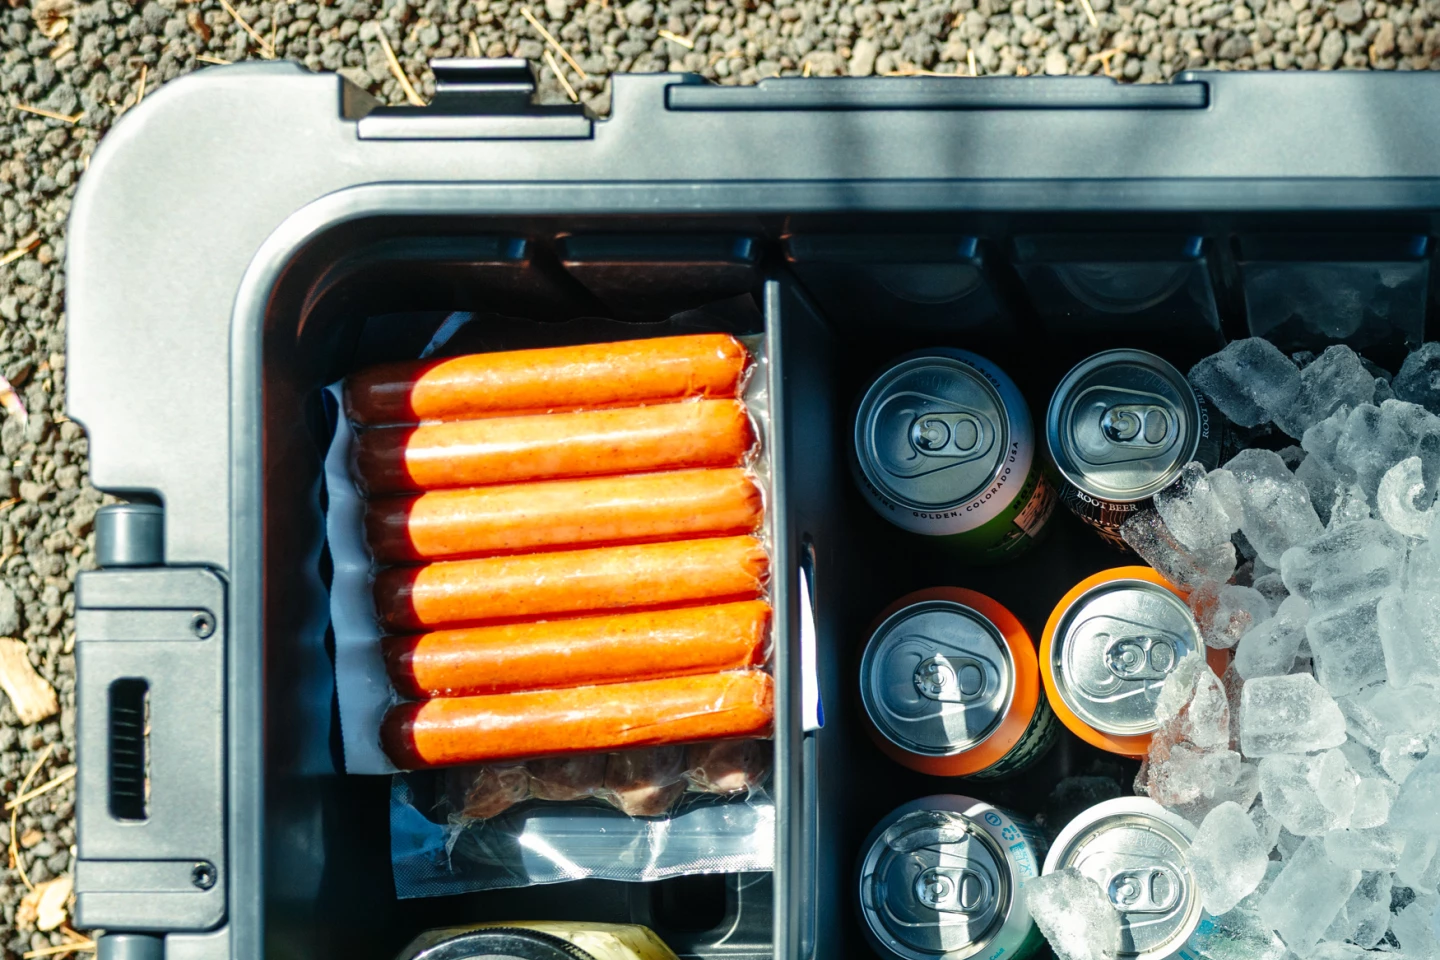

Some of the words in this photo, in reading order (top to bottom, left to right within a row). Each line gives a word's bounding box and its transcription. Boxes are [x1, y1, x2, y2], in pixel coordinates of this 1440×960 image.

[912, 511, 962, 520] GOLDEN,
[966, 467, 1011, 512] COLORADO
[1009, 441, 1019, 463] USA
[1076, 489, 1107, 511] ROOT
[1109, 503, 1139, 512] BEER
